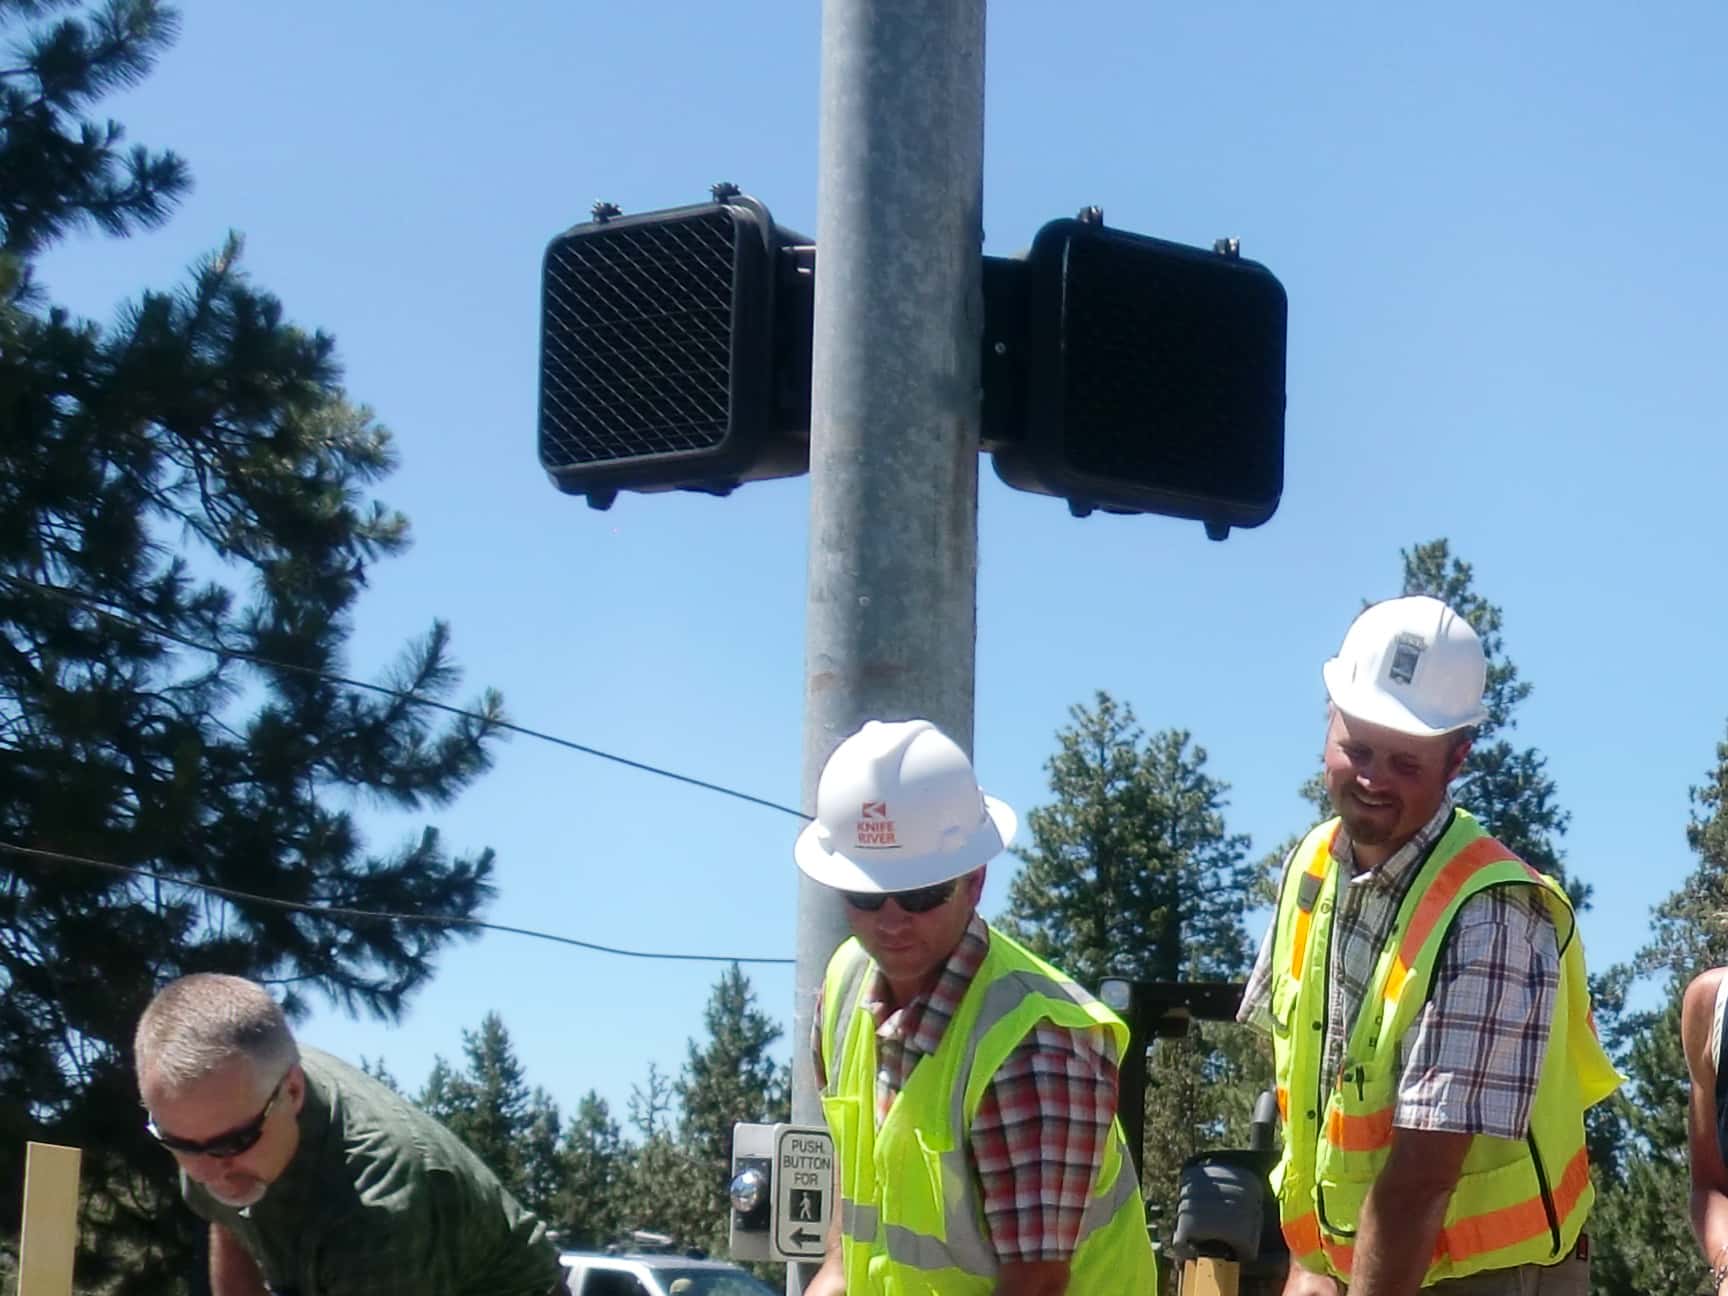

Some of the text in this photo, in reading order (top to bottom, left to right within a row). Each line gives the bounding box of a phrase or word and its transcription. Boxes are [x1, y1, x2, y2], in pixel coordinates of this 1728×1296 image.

[857, 821, 895, 832] KNIFE
[858, 833, 896, 844] RIVER
[791, 1139, 823, 1154] PUSH
[783, 1155, 831, 1169] BUTTON
[794, 1172, 819, 1186] FOR
